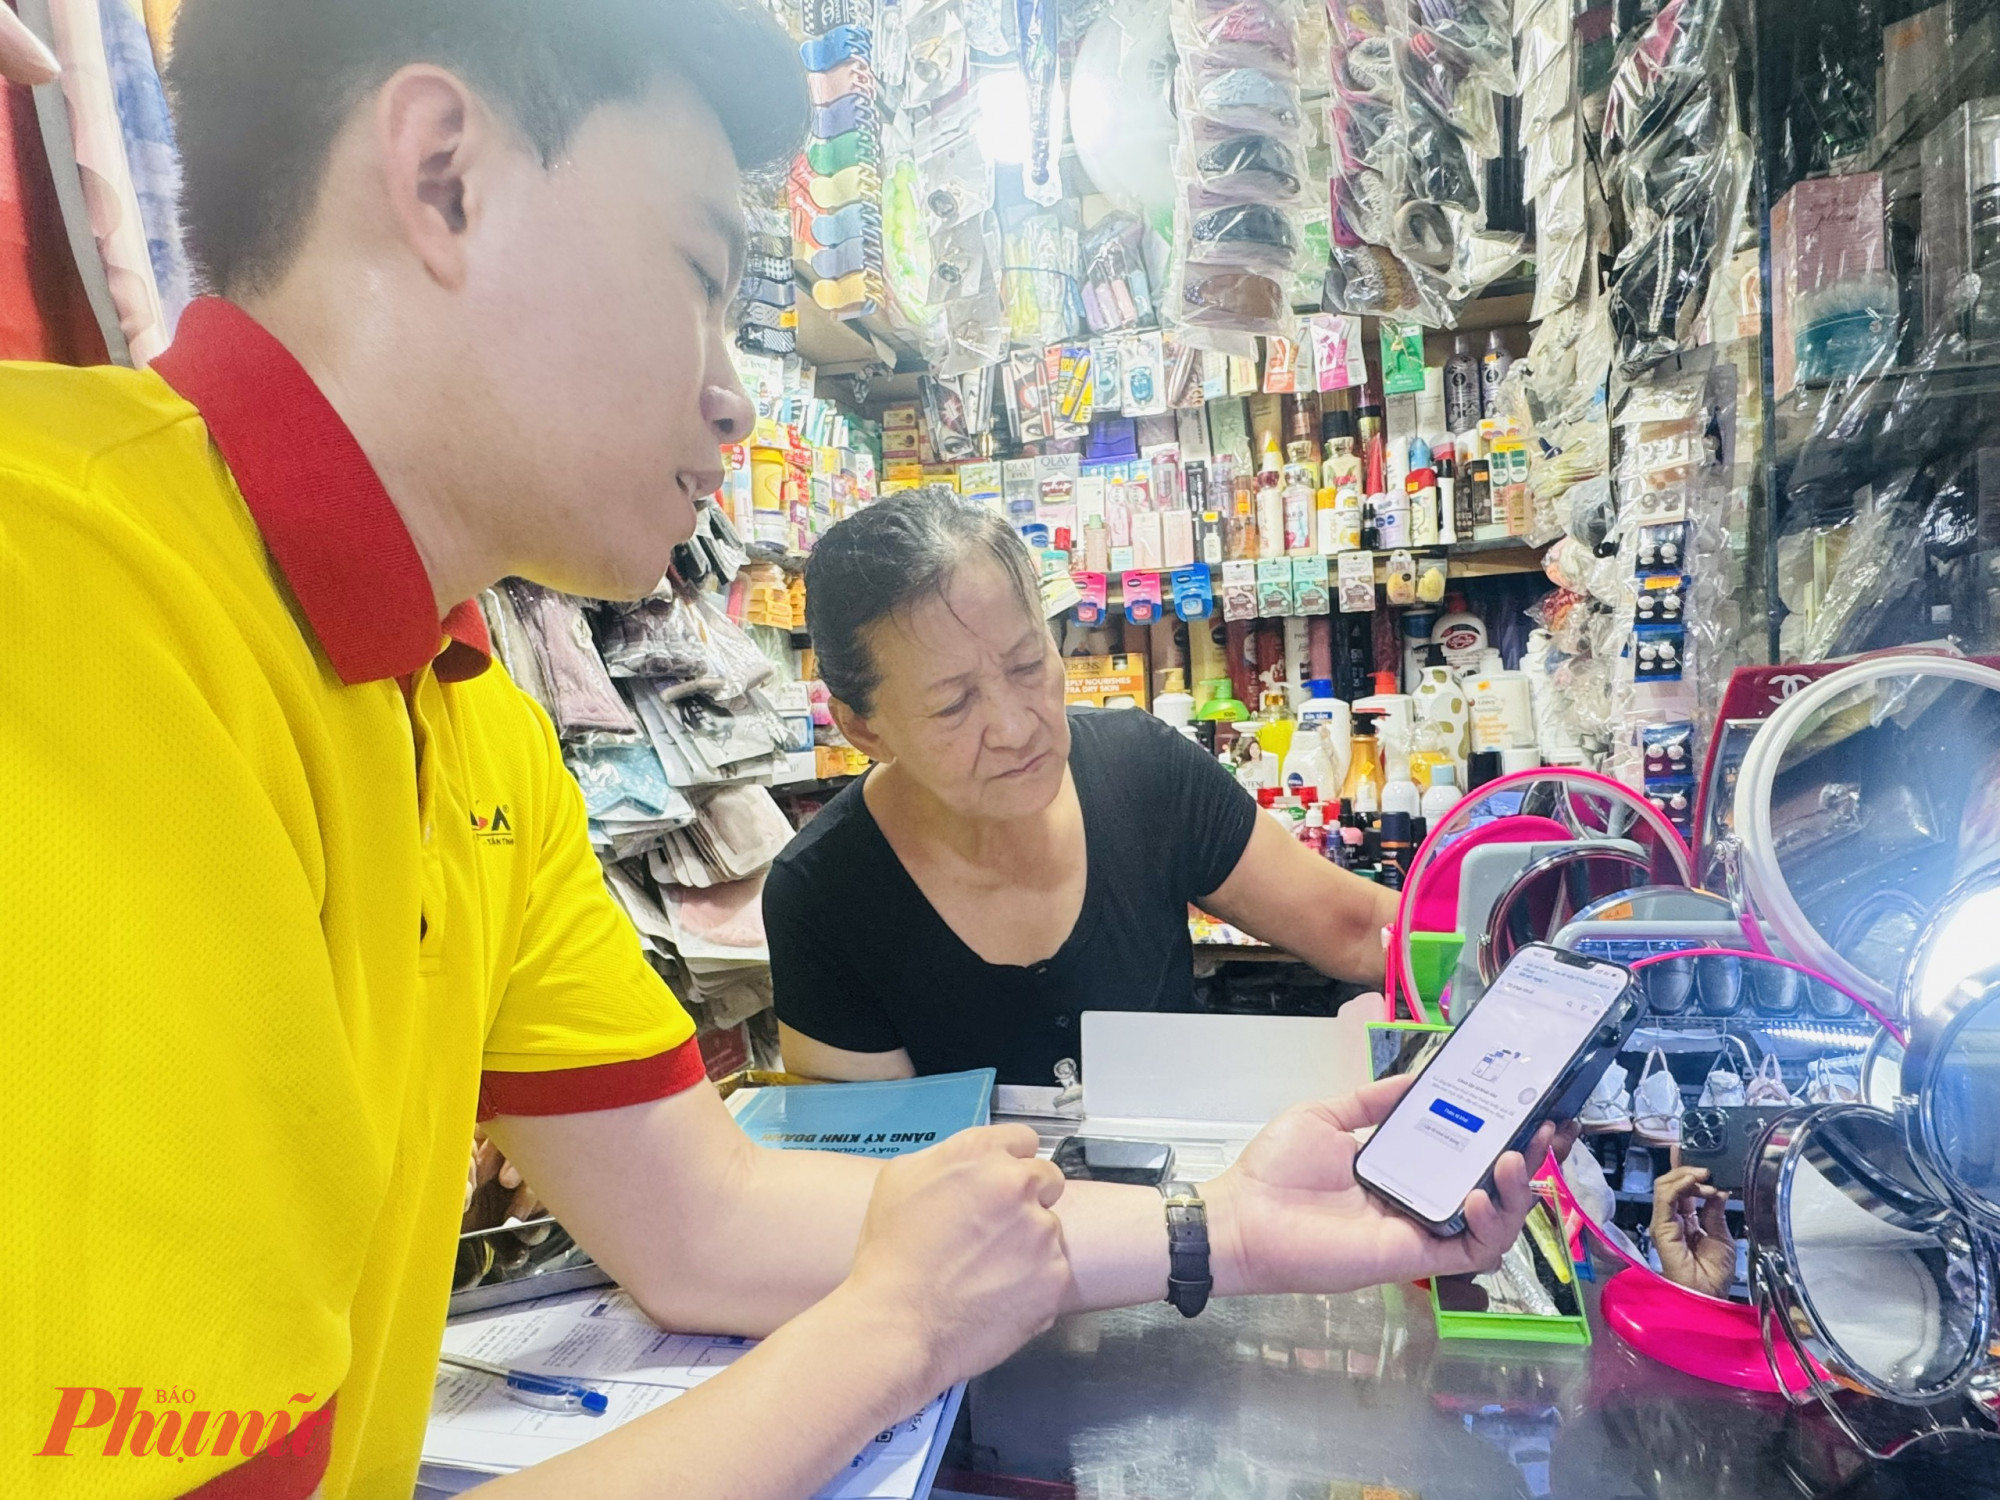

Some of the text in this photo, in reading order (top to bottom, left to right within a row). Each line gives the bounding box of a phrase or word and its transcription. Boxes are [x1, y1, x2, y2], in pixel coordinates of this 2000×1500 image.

[1041, 456, 1070, 466] OLAY
[1006, 462, 1031, 471] OLAY
[1085, 677, 1131, 686] NOURISHES
[762, 1133, 817, 1143] DOANH
[819, 1133, 861, 1143] KINH
[889, 1131, 937, 1144] ĐĂNG
